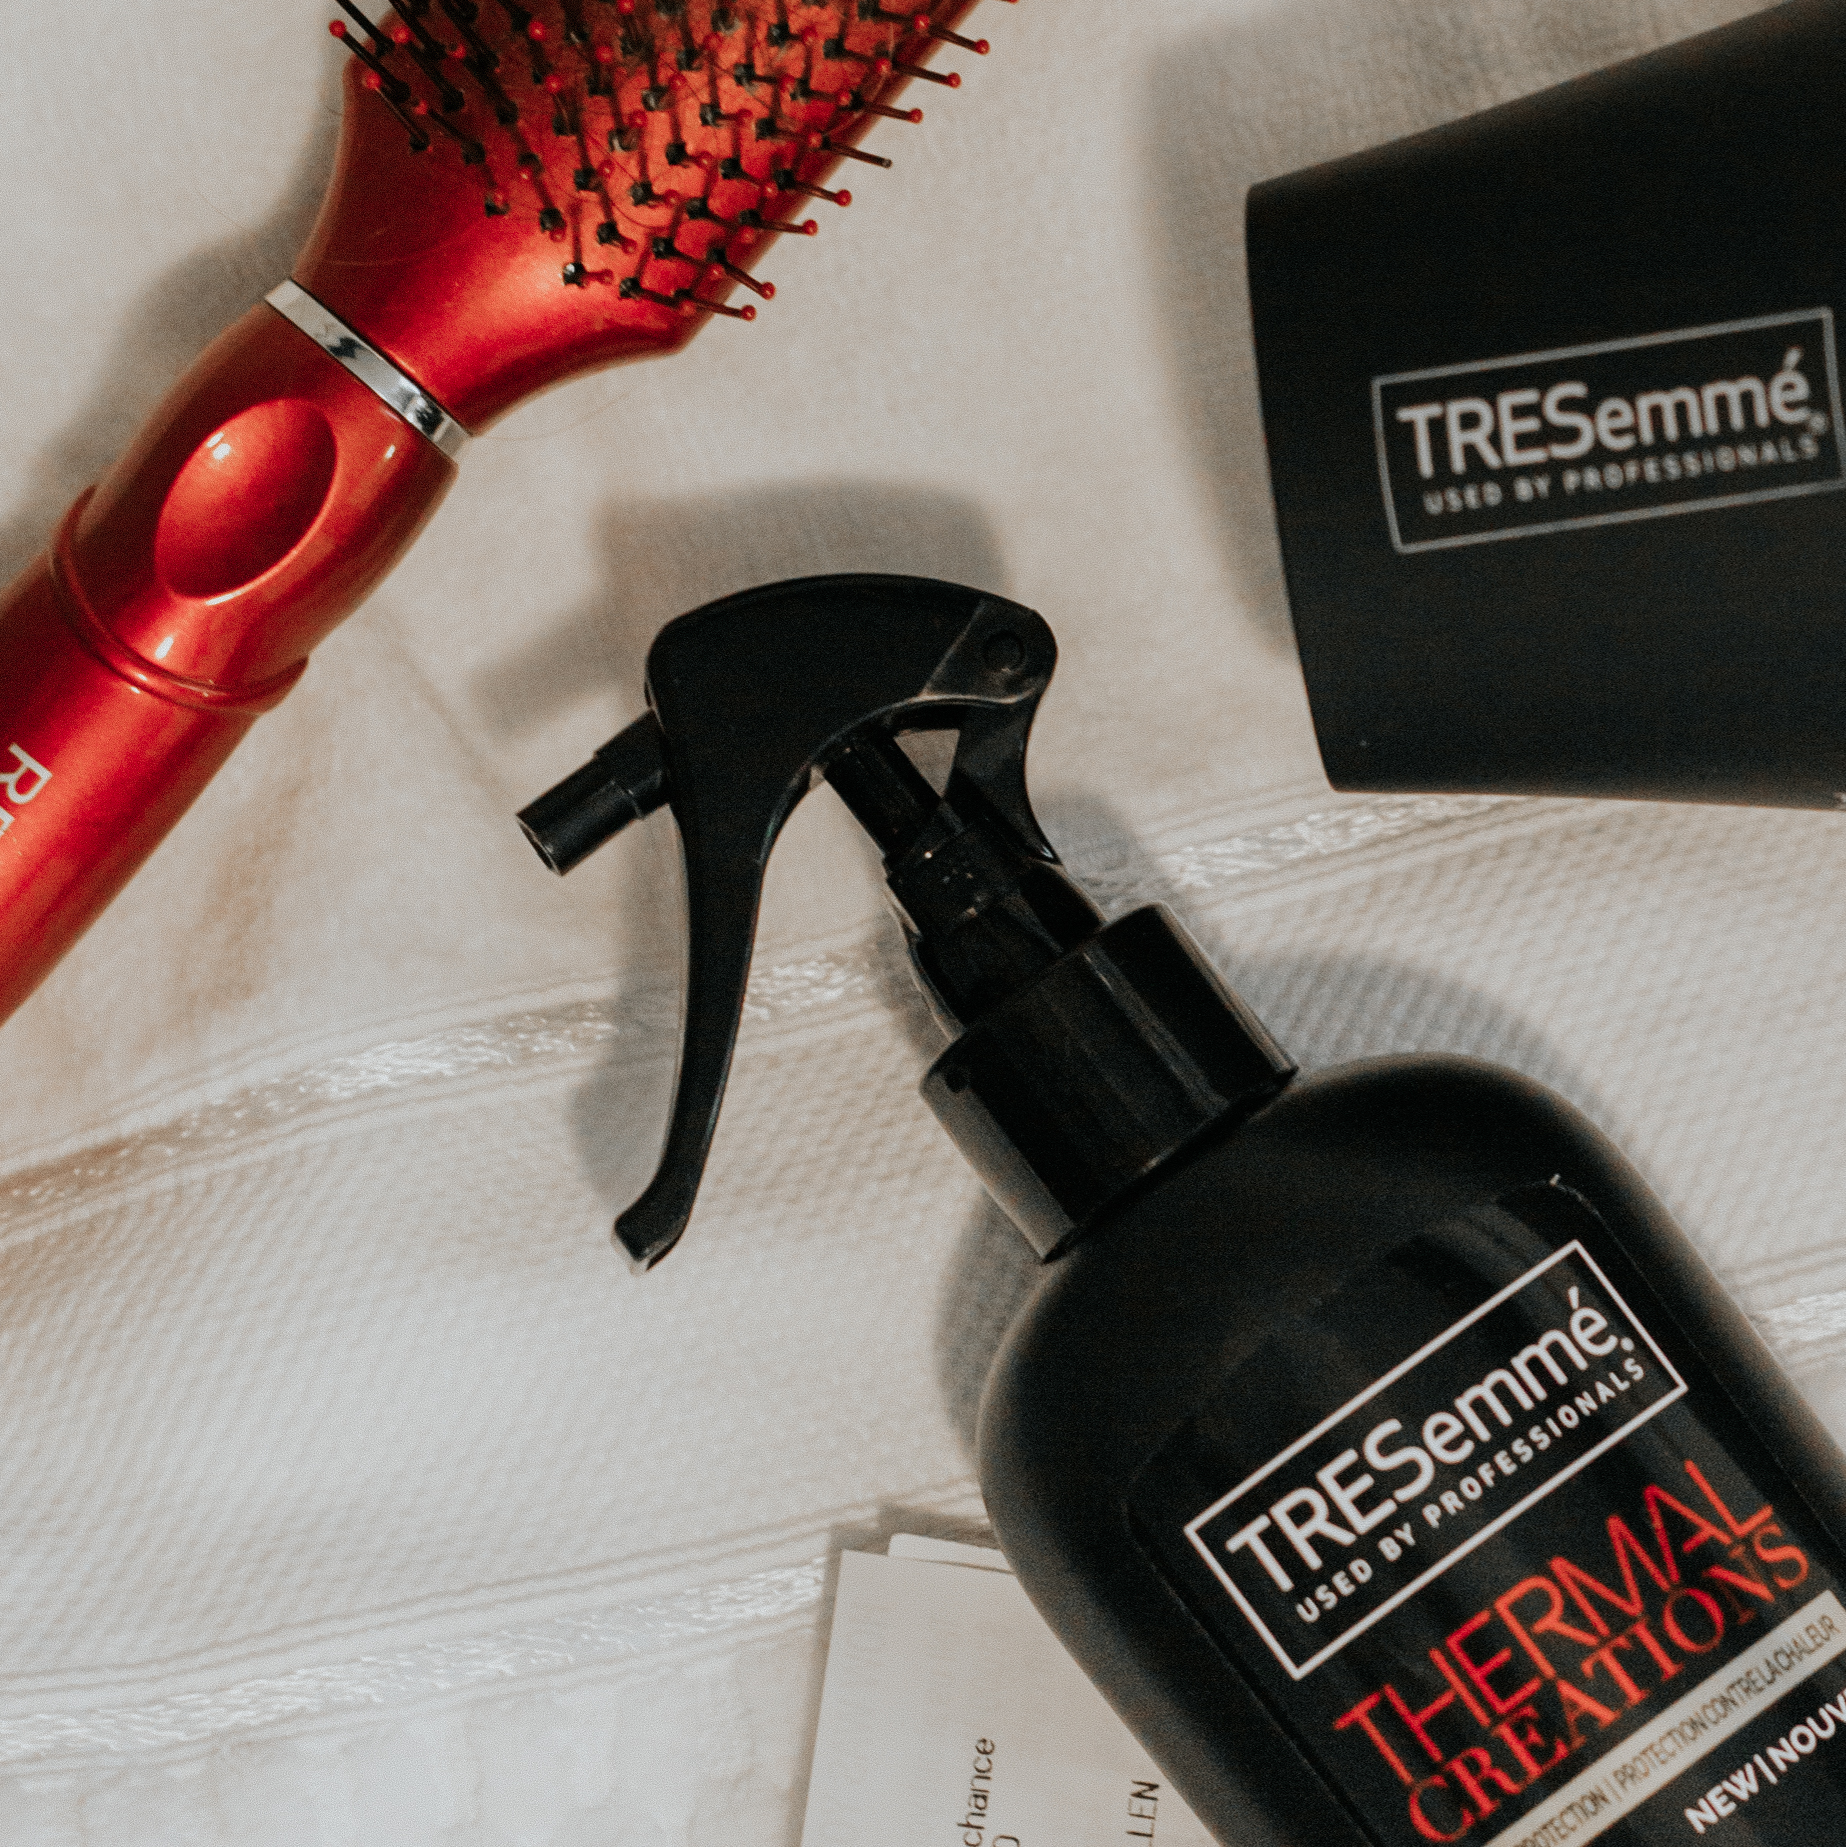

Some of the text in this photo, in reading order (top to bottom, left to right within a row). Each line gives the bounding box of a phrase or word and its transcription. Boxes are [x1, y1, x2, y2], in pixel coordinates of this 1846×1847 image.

[1394, 345, 1819, 481] TRESemmé
[1422, 430, 1821, 516] USED BY PROFESSIONALS
[1220, 1282, 1631, 1599] TRESemmé
[1292, 1354, 1648, 1626] USED BY PROFESSIONALS
[1329, 1447, 1778, 1792] THERMAL
[1682, 1761, 1764, 1836] NEW
